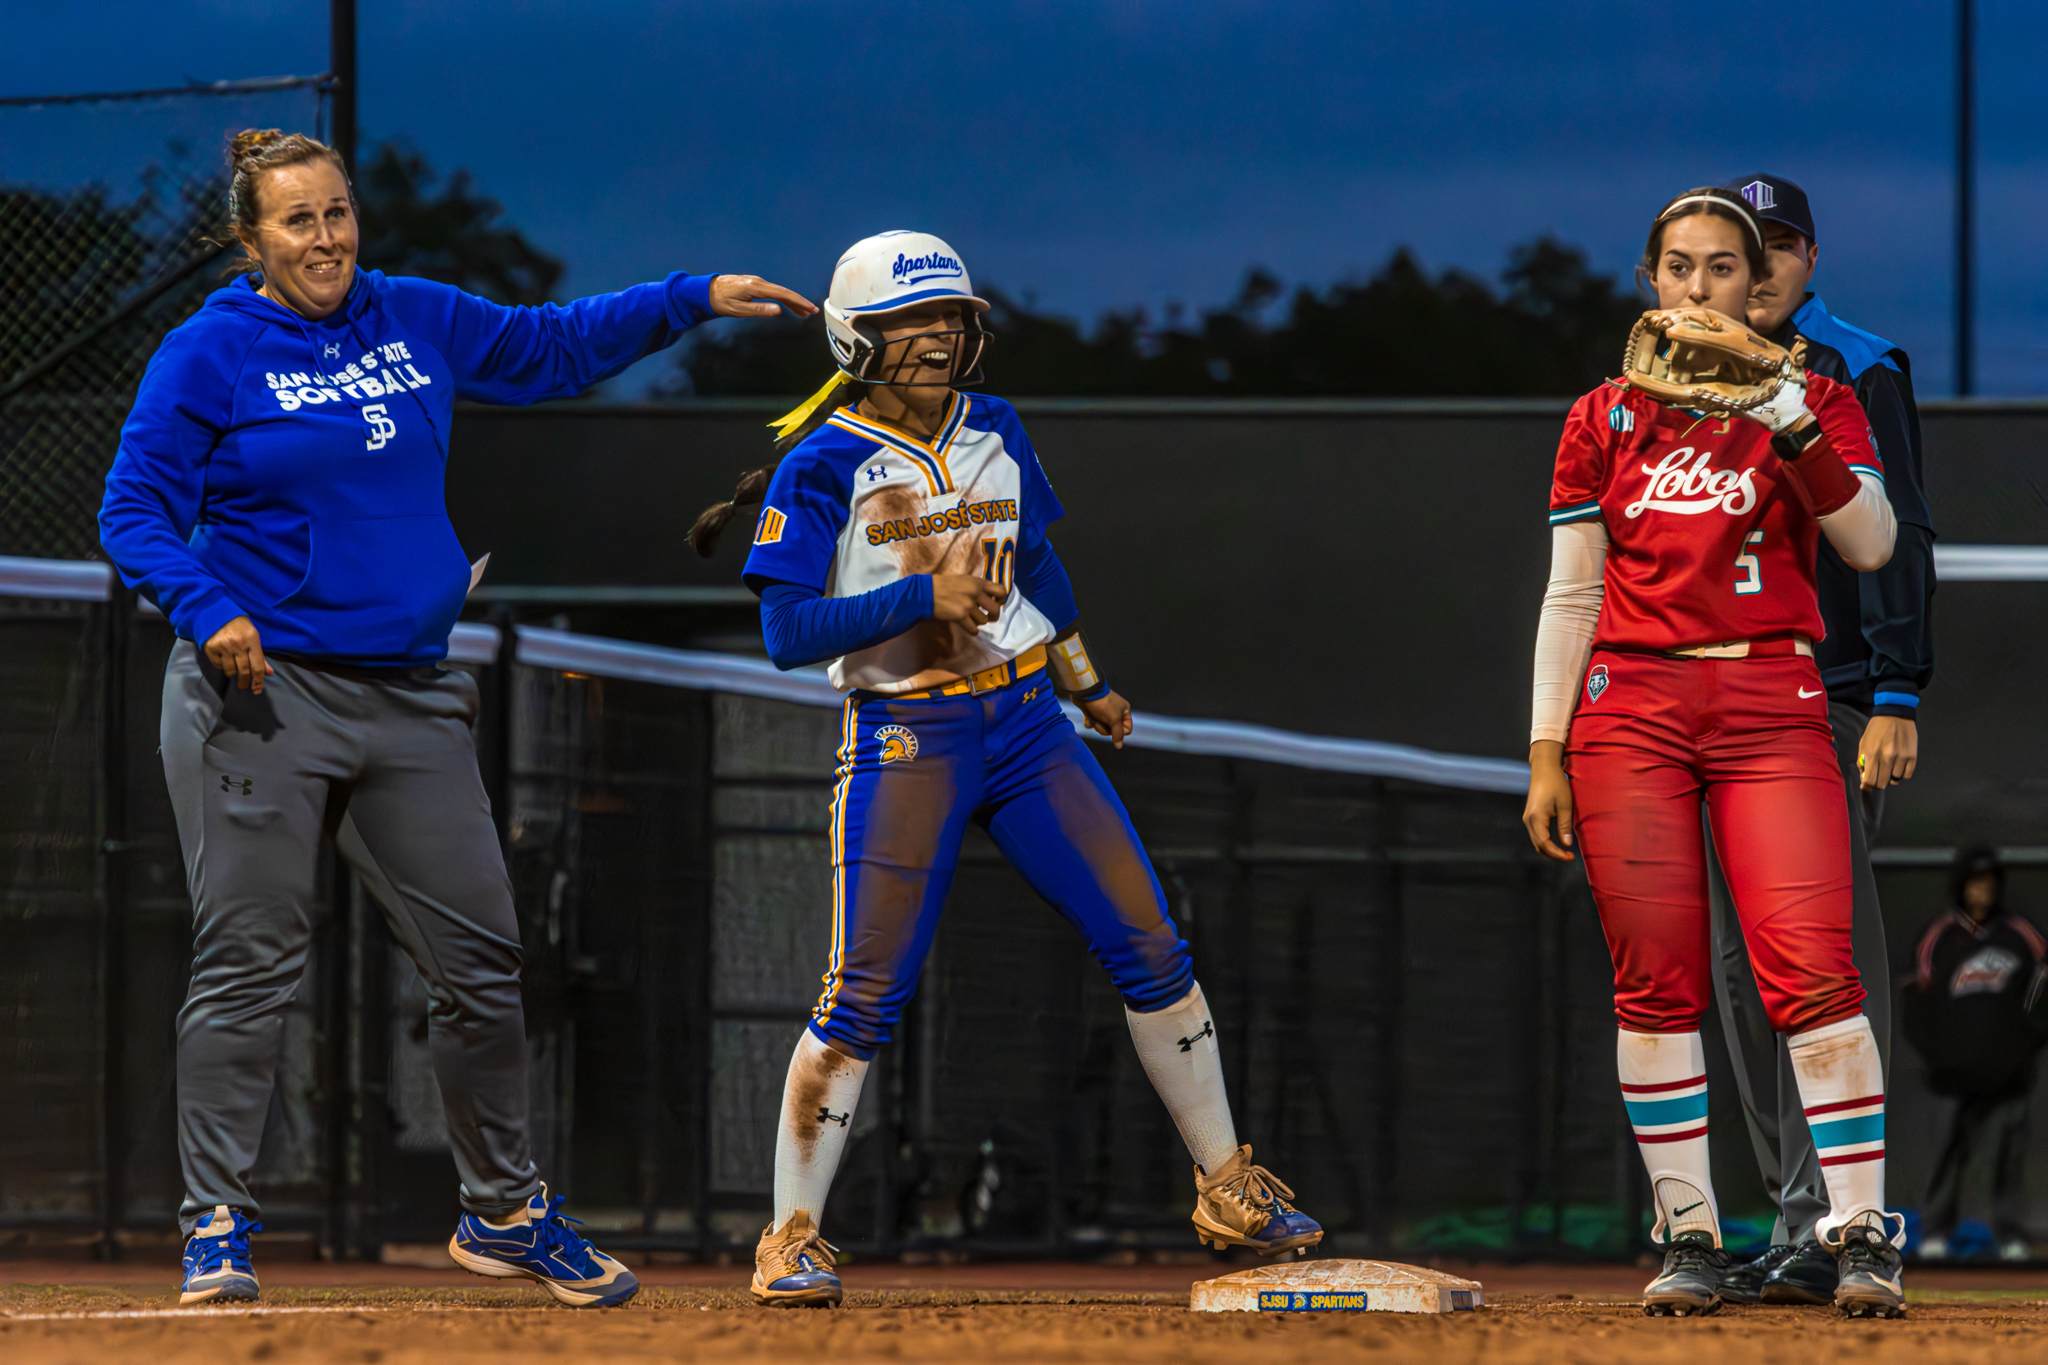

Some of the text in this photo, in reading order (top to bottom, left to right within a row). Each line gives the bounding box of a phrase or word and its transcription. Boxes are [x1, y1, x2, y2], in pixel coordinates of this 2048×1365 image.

[893, 252, 962, 279] Spartans
[266, 341, 412, 389] SAN JSE SATE
[275, 364, 431, 411] SOFTBALL
[1625, 446, 1756, 519] Lobos
[866, 498, 1018, 546] SAN JOSÉ STATE
[981, 536, 1016, 605] 10
[1734, 529, 1765, 595] 5
[1260, 1294, 1364, 1309] SJSU SPARTANS
